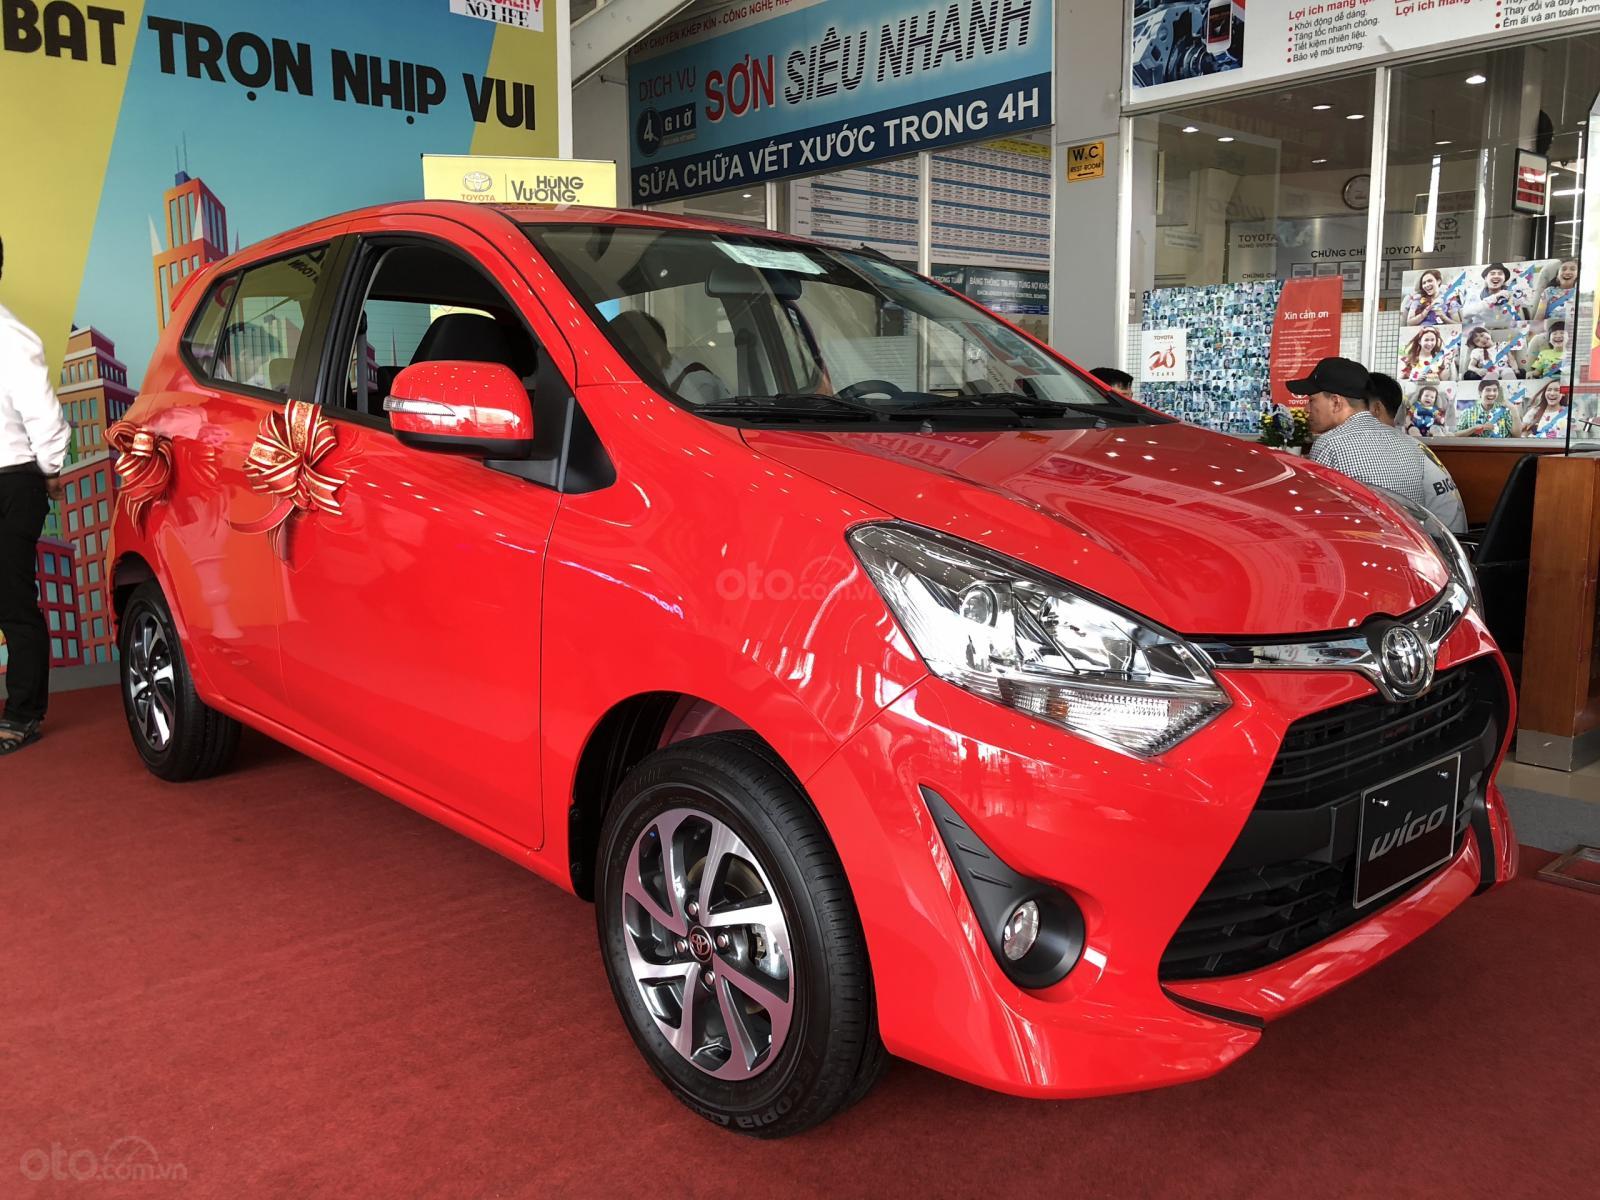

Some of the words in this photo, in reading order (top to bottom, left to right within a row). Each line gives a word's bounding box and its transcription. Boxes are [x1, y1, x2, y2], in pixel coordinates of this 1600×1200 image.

[466, 1, 488, 18] NO
[492, 4, 529, 27] LIFE
[723, 7, 747, 24] CÔNG
[1288, 8, 1306, 20] Lợi
[1327, 0, 1356, 11] mang
[1396, 3, 1414, 16] Lợi
[1503, 6, 1526, 16] Thay
[1544, 12, 1557, 20] an
[1294, 19, 1312, 31] Khởi
[1328, 22, 1352, 34] nhanh
[785, 27, 868, 104] SIÊU
[877, 0, 1033, 82] NHANH
[1293, 53, 1308, 62] Bảo
[1309, 49, 1319, 58] vệ
[148, 16, 313, 101] TRỌN
[331, 48, 446, 125] NHỊP
[463, 72, 536, 130] VUI
[677, 65, 696, 92] VỤ
[705, 54, 776, 122] SƠN
[664, 109, 693, 131] GIỜ
[639, 167, 679, 197] SỬA
[684, 153, 744, 187] CHỮA
[749, 140, 792, 175] VẾT
[799, 123, 875, 165] XƯỚC
[884, 100, 988, 148] TRONG
[998, 87, 1039, 123] 4H
[1072, 146, 1099, 161] W.C
[536, 174, 584, 190] HÙNG
[461, 194, 496, 202] TOYOTA
[1385, 245, 1422, 255] TOYOTA
[1284, 312, 1298, 321] Xin
[1149, 348, 1176, 371] 20
